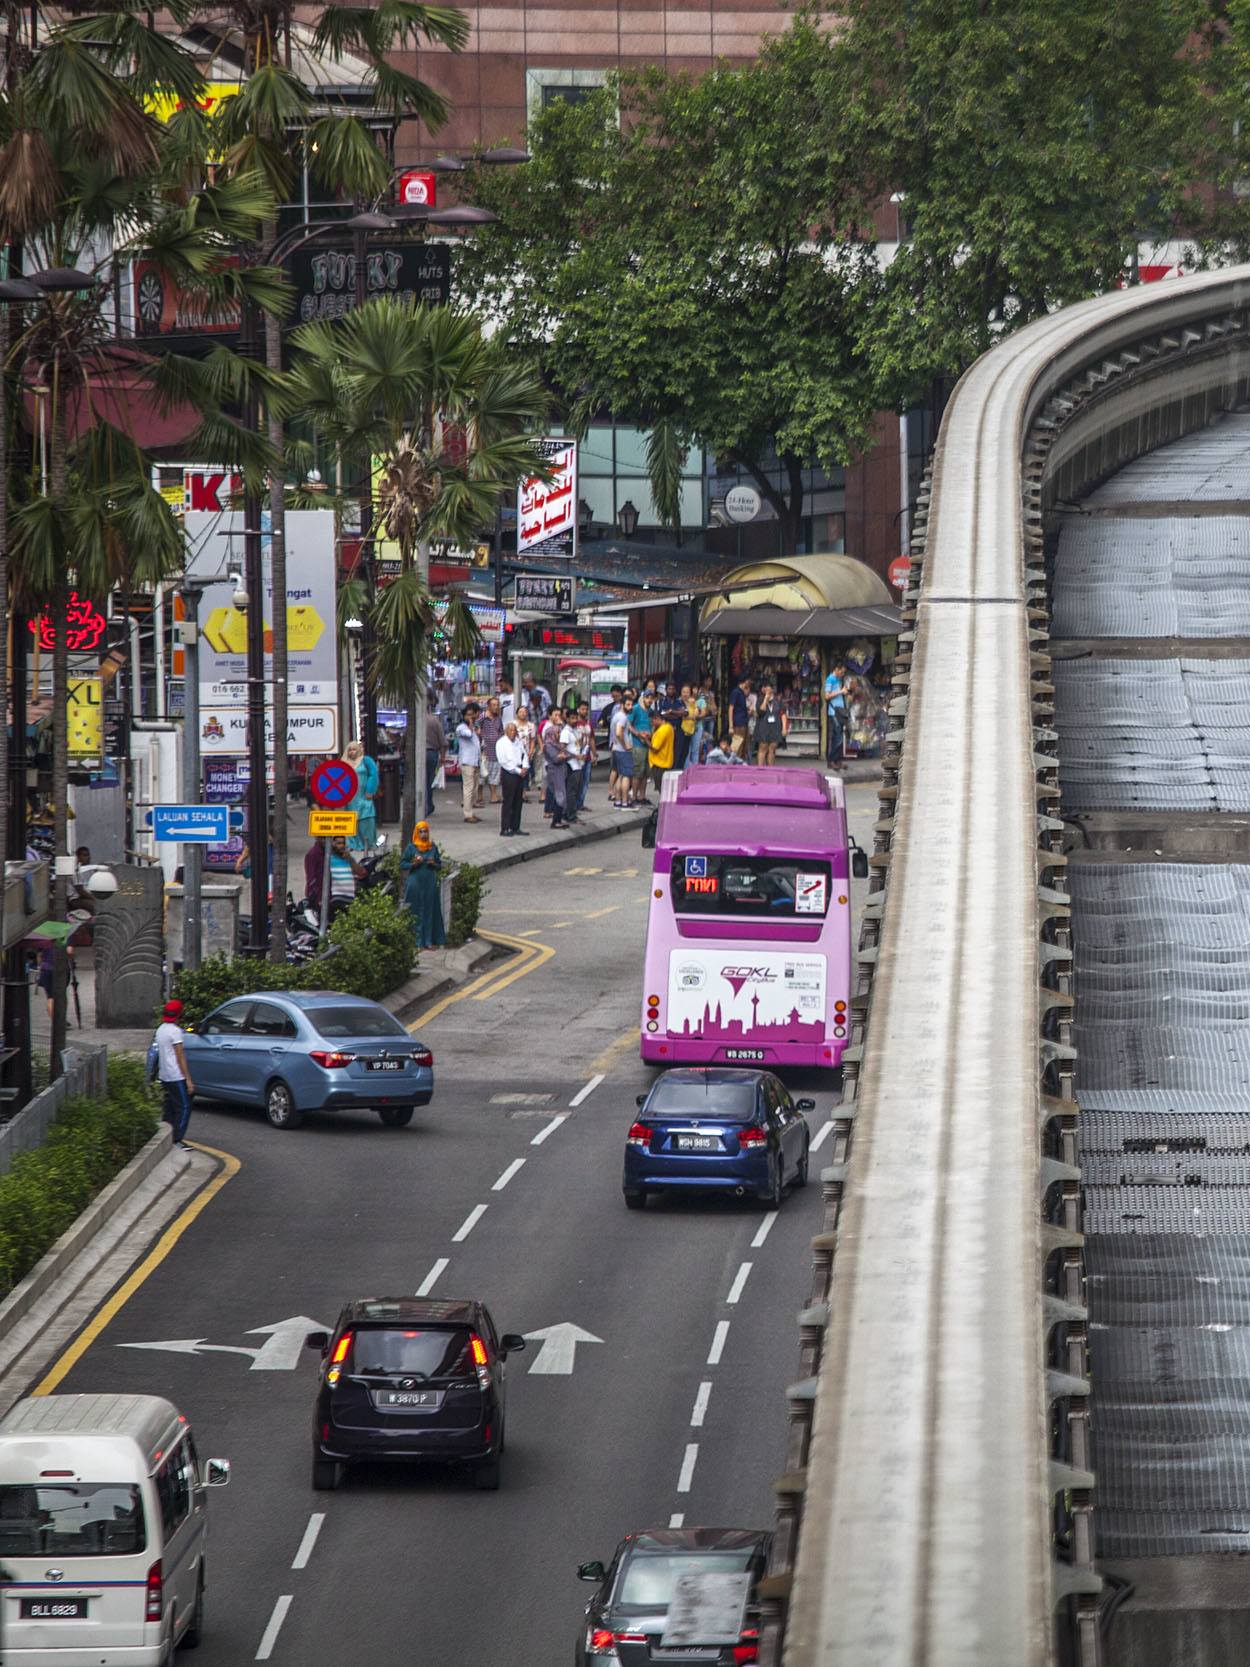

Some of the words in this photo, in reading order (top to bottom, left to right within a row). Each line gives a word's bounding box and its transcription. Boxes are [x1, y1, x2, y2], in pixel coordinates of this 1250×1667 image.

[230, 719, 271, 730] KUA
[206, 783, 243, 793] CHANGER
[157, 812, 188, 822] LALUAN
[191, 812, 224, 822] SEHALA
[720, 966, 778, 978] GOKL
[31, 1604, 51, 1615] BLL
[52, 1604, 78, 1615] 6829
